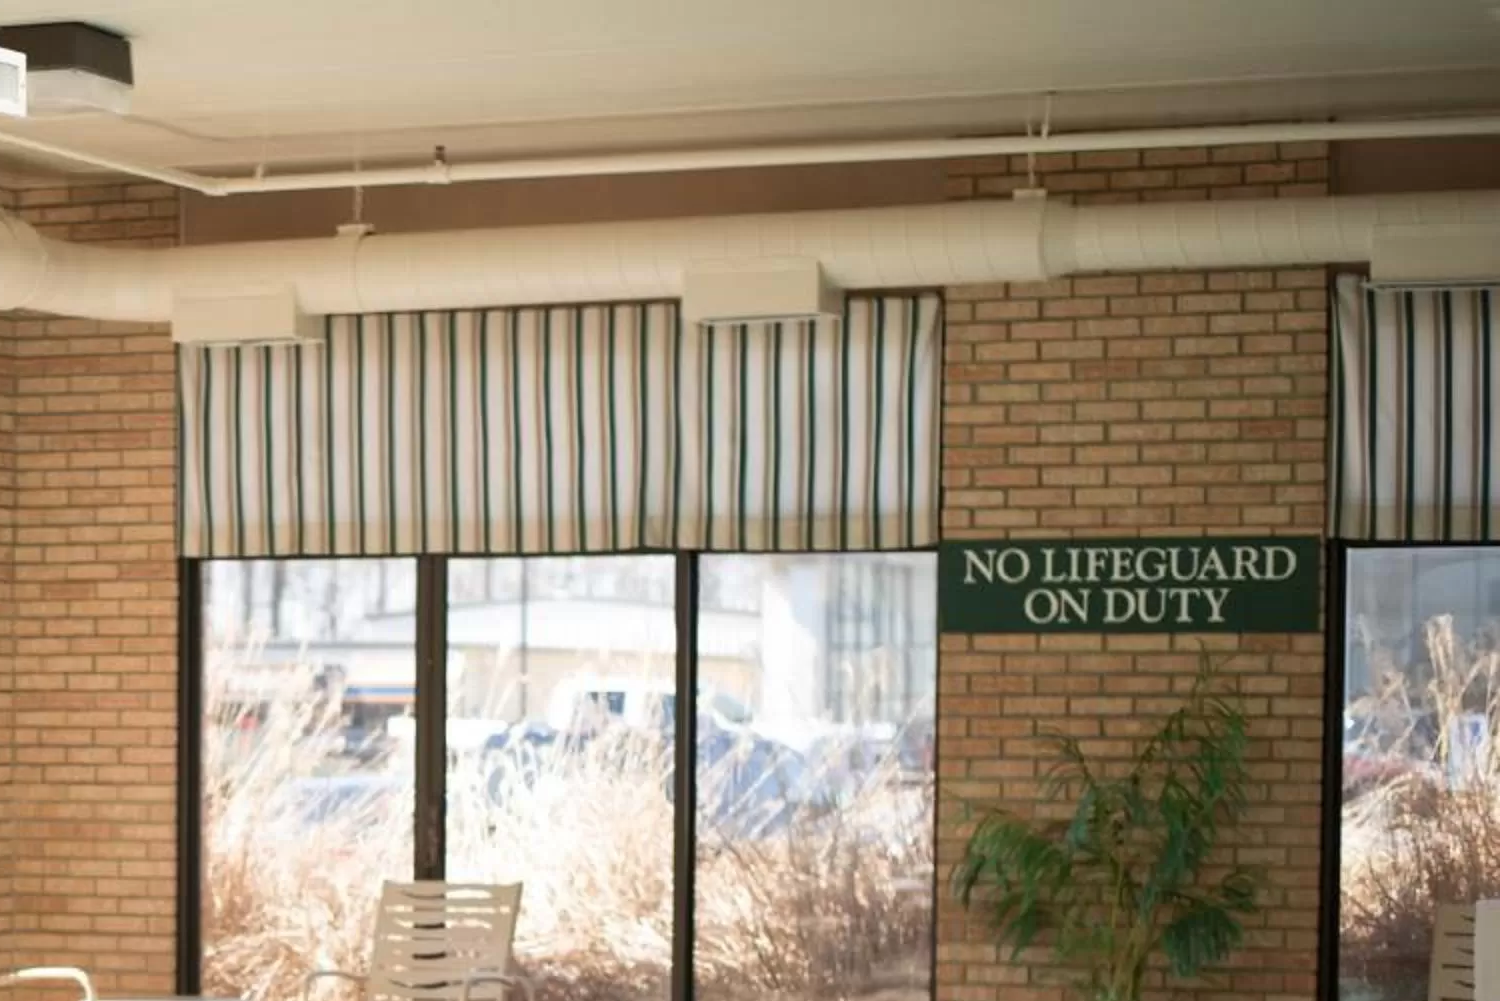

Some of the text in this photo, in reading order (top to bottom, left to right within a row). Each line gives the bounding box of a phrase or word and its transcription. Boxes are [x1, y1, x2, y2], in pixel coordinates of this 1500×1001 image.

[963, 545, 1297, 584] NO LIFEGUARD
[1023, 586, 1232, 625] ON DUTY
